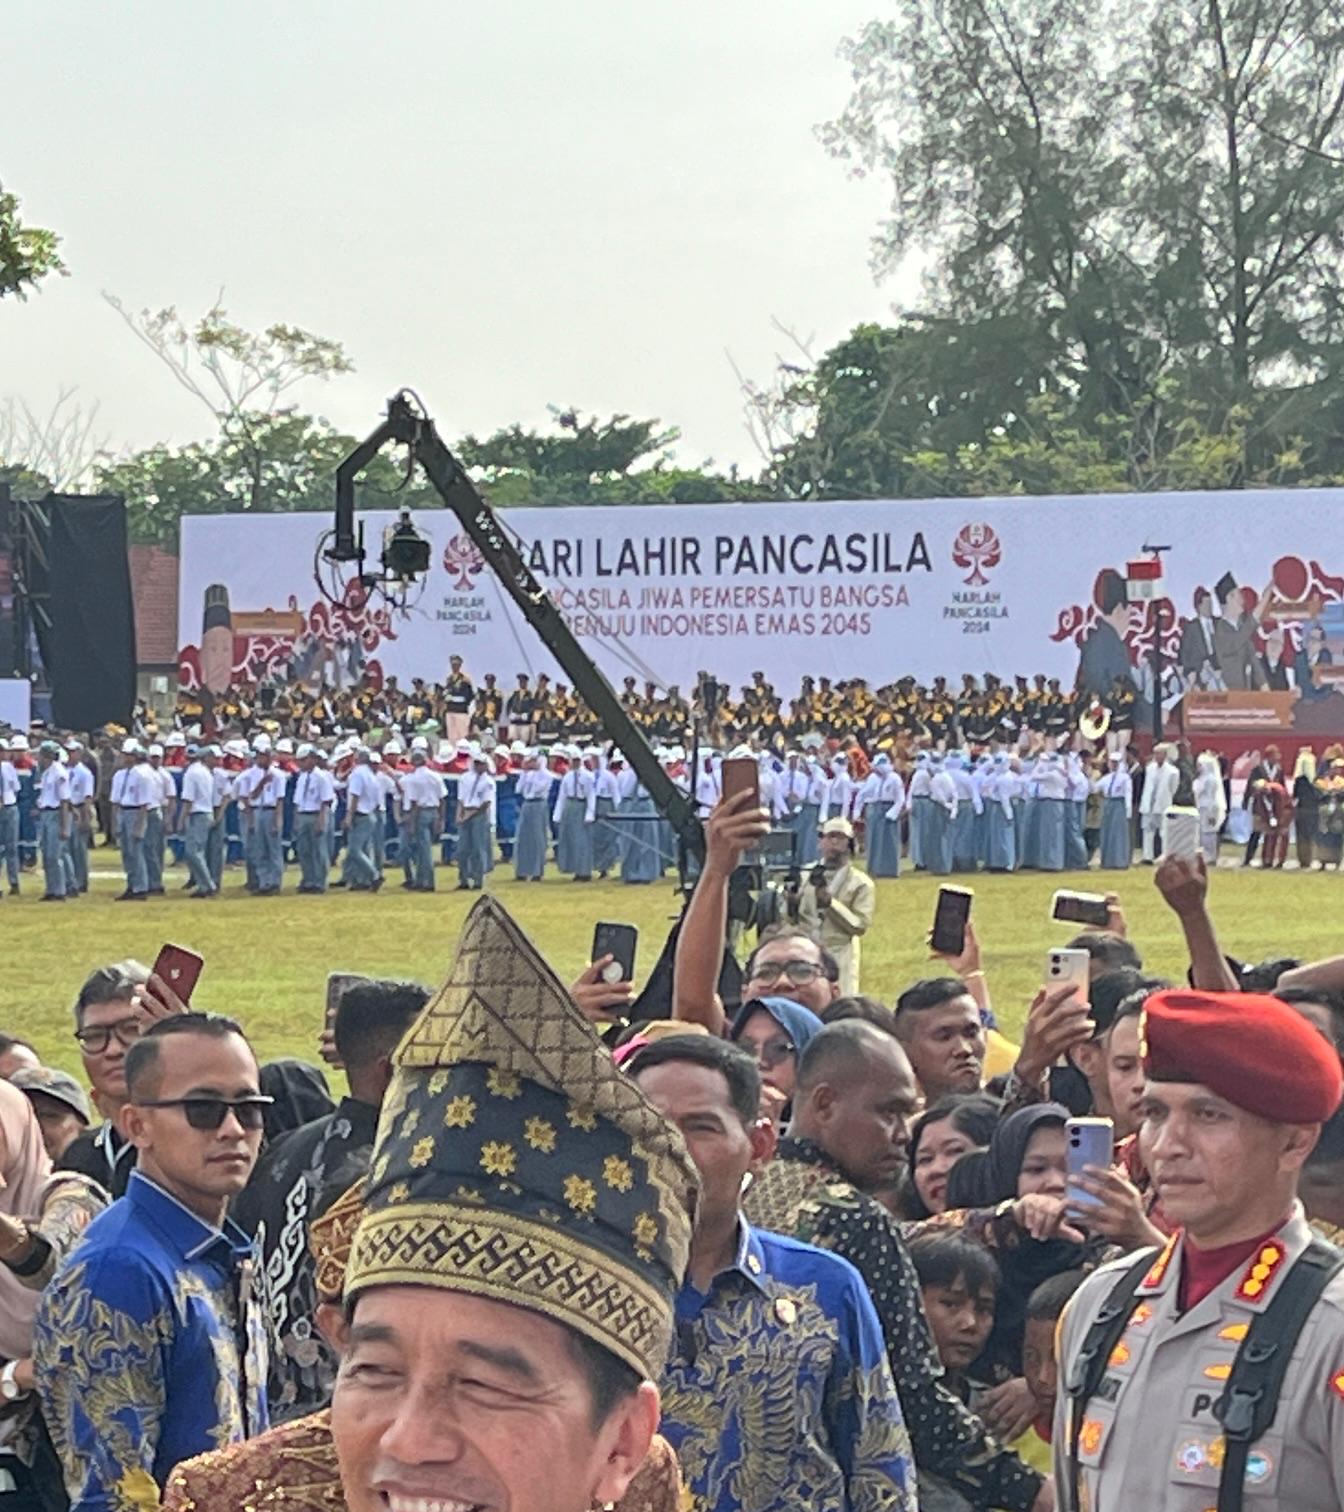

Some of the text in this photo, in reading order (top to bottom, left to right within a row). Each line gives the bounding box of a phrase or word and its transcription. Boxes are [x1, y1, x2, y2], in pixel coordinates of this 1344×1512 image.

[517, 532, 933, 577] ARI LAHIR PANCASILA
[547, 584, 910, 610] NCASILA JIWA PEMERSATU BANGSA
[640, 613, 749, 636] INDONESIA
[755, 613, 816, 635] EMAS
[820, 612, 872, 635] 2045
[942, 606, 1010, 618] PANCASILA
